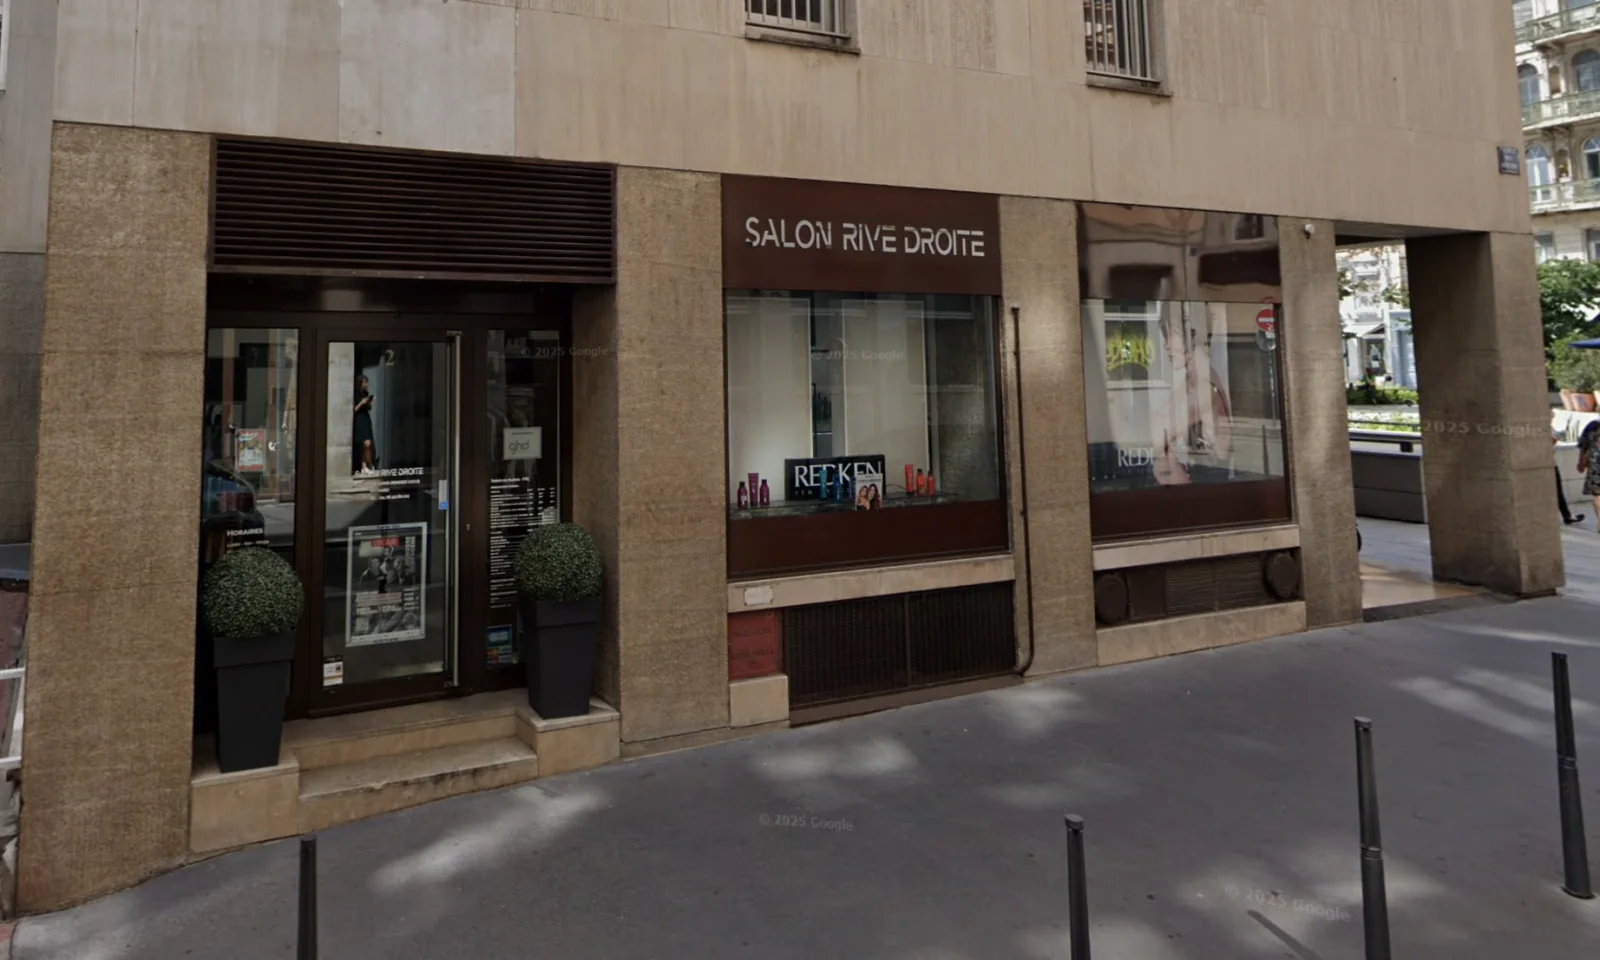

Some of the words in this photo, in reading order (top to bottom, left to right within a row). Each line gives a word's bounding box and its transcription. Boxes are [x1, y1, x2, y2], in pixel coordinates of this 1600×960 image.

[745, 216, 832, 249] SALON
[842, 222, 897, 253] RIVE
[904, 226, 985, 257] DROITE
[384, 348, 396, 366] 2
[508, 439, 530, 456] ghd
[398, 467, 424, 476] DROITE
